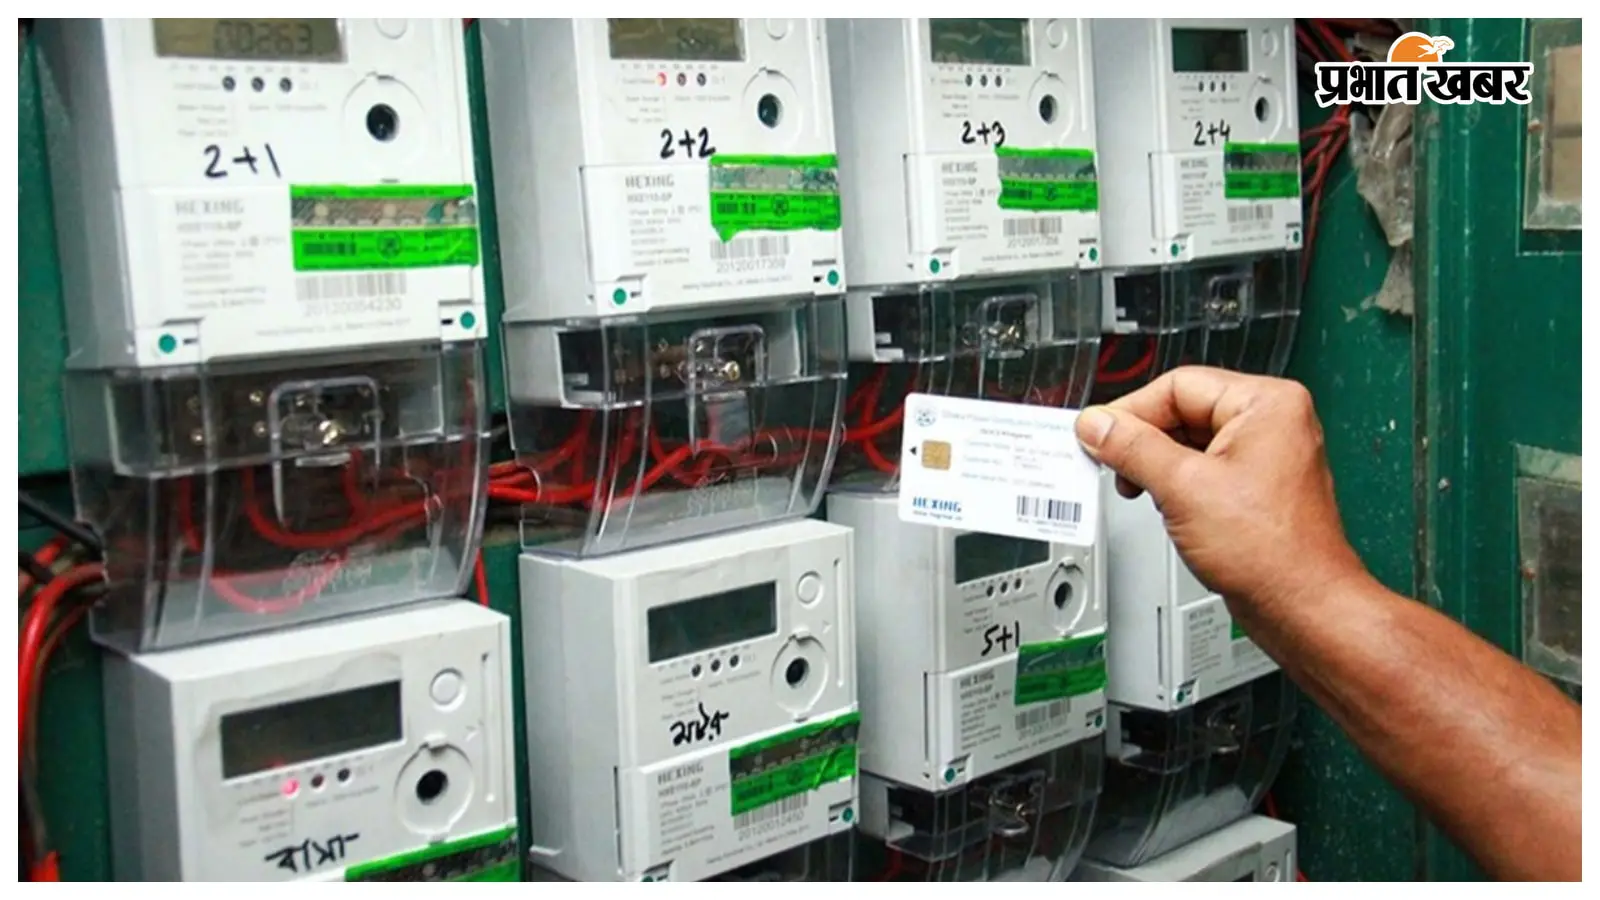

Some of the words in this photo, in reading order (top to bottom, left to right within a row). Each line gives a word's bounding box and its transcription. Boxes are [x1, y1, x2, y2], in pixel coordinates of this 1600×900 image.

[660, 126, 717, 160] 2+2
[961, 120, 1006, 147] 2+3
[1193, 118, 1231, 146] 2+4
[204, 143, 282, 179] 2+1
[625, 173, 675, 188] HEXING
[912, 495, 962, 513] HEXING
[980, 619, 1020, 657] 5+1
[657, 760, 704, 786] HEXING
